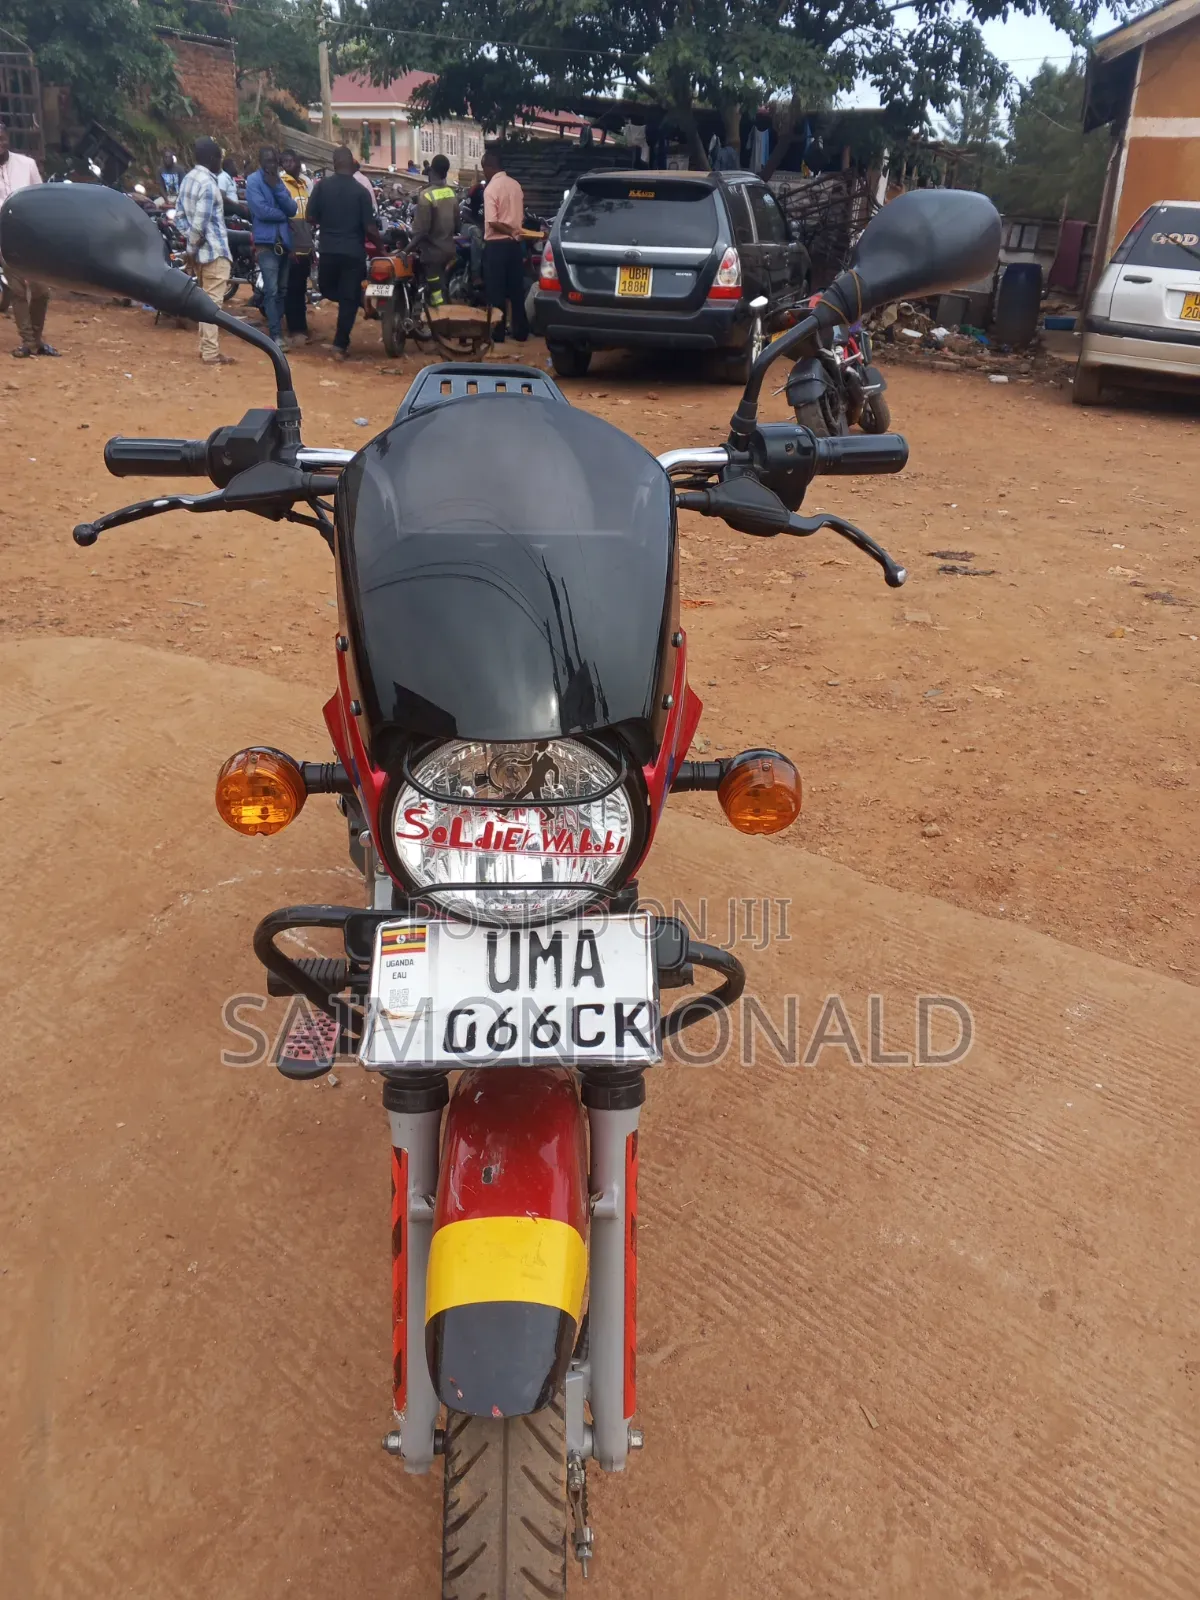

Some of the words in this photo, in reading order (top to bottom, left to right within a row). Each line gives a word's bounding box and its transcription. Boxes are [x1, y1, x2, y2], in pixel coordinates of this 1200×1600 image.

[1151, 232, 1199, 246] GOD
[628, 267, 649, 280] UBH
[621, 281, 646, 292] 188H
[386, 959, 414, 968] UGANDA
[486, 929, 605, 993] UMA
[392, 972, 407, 980] EAU
[443, 1000, 651, 1053] 066CK
